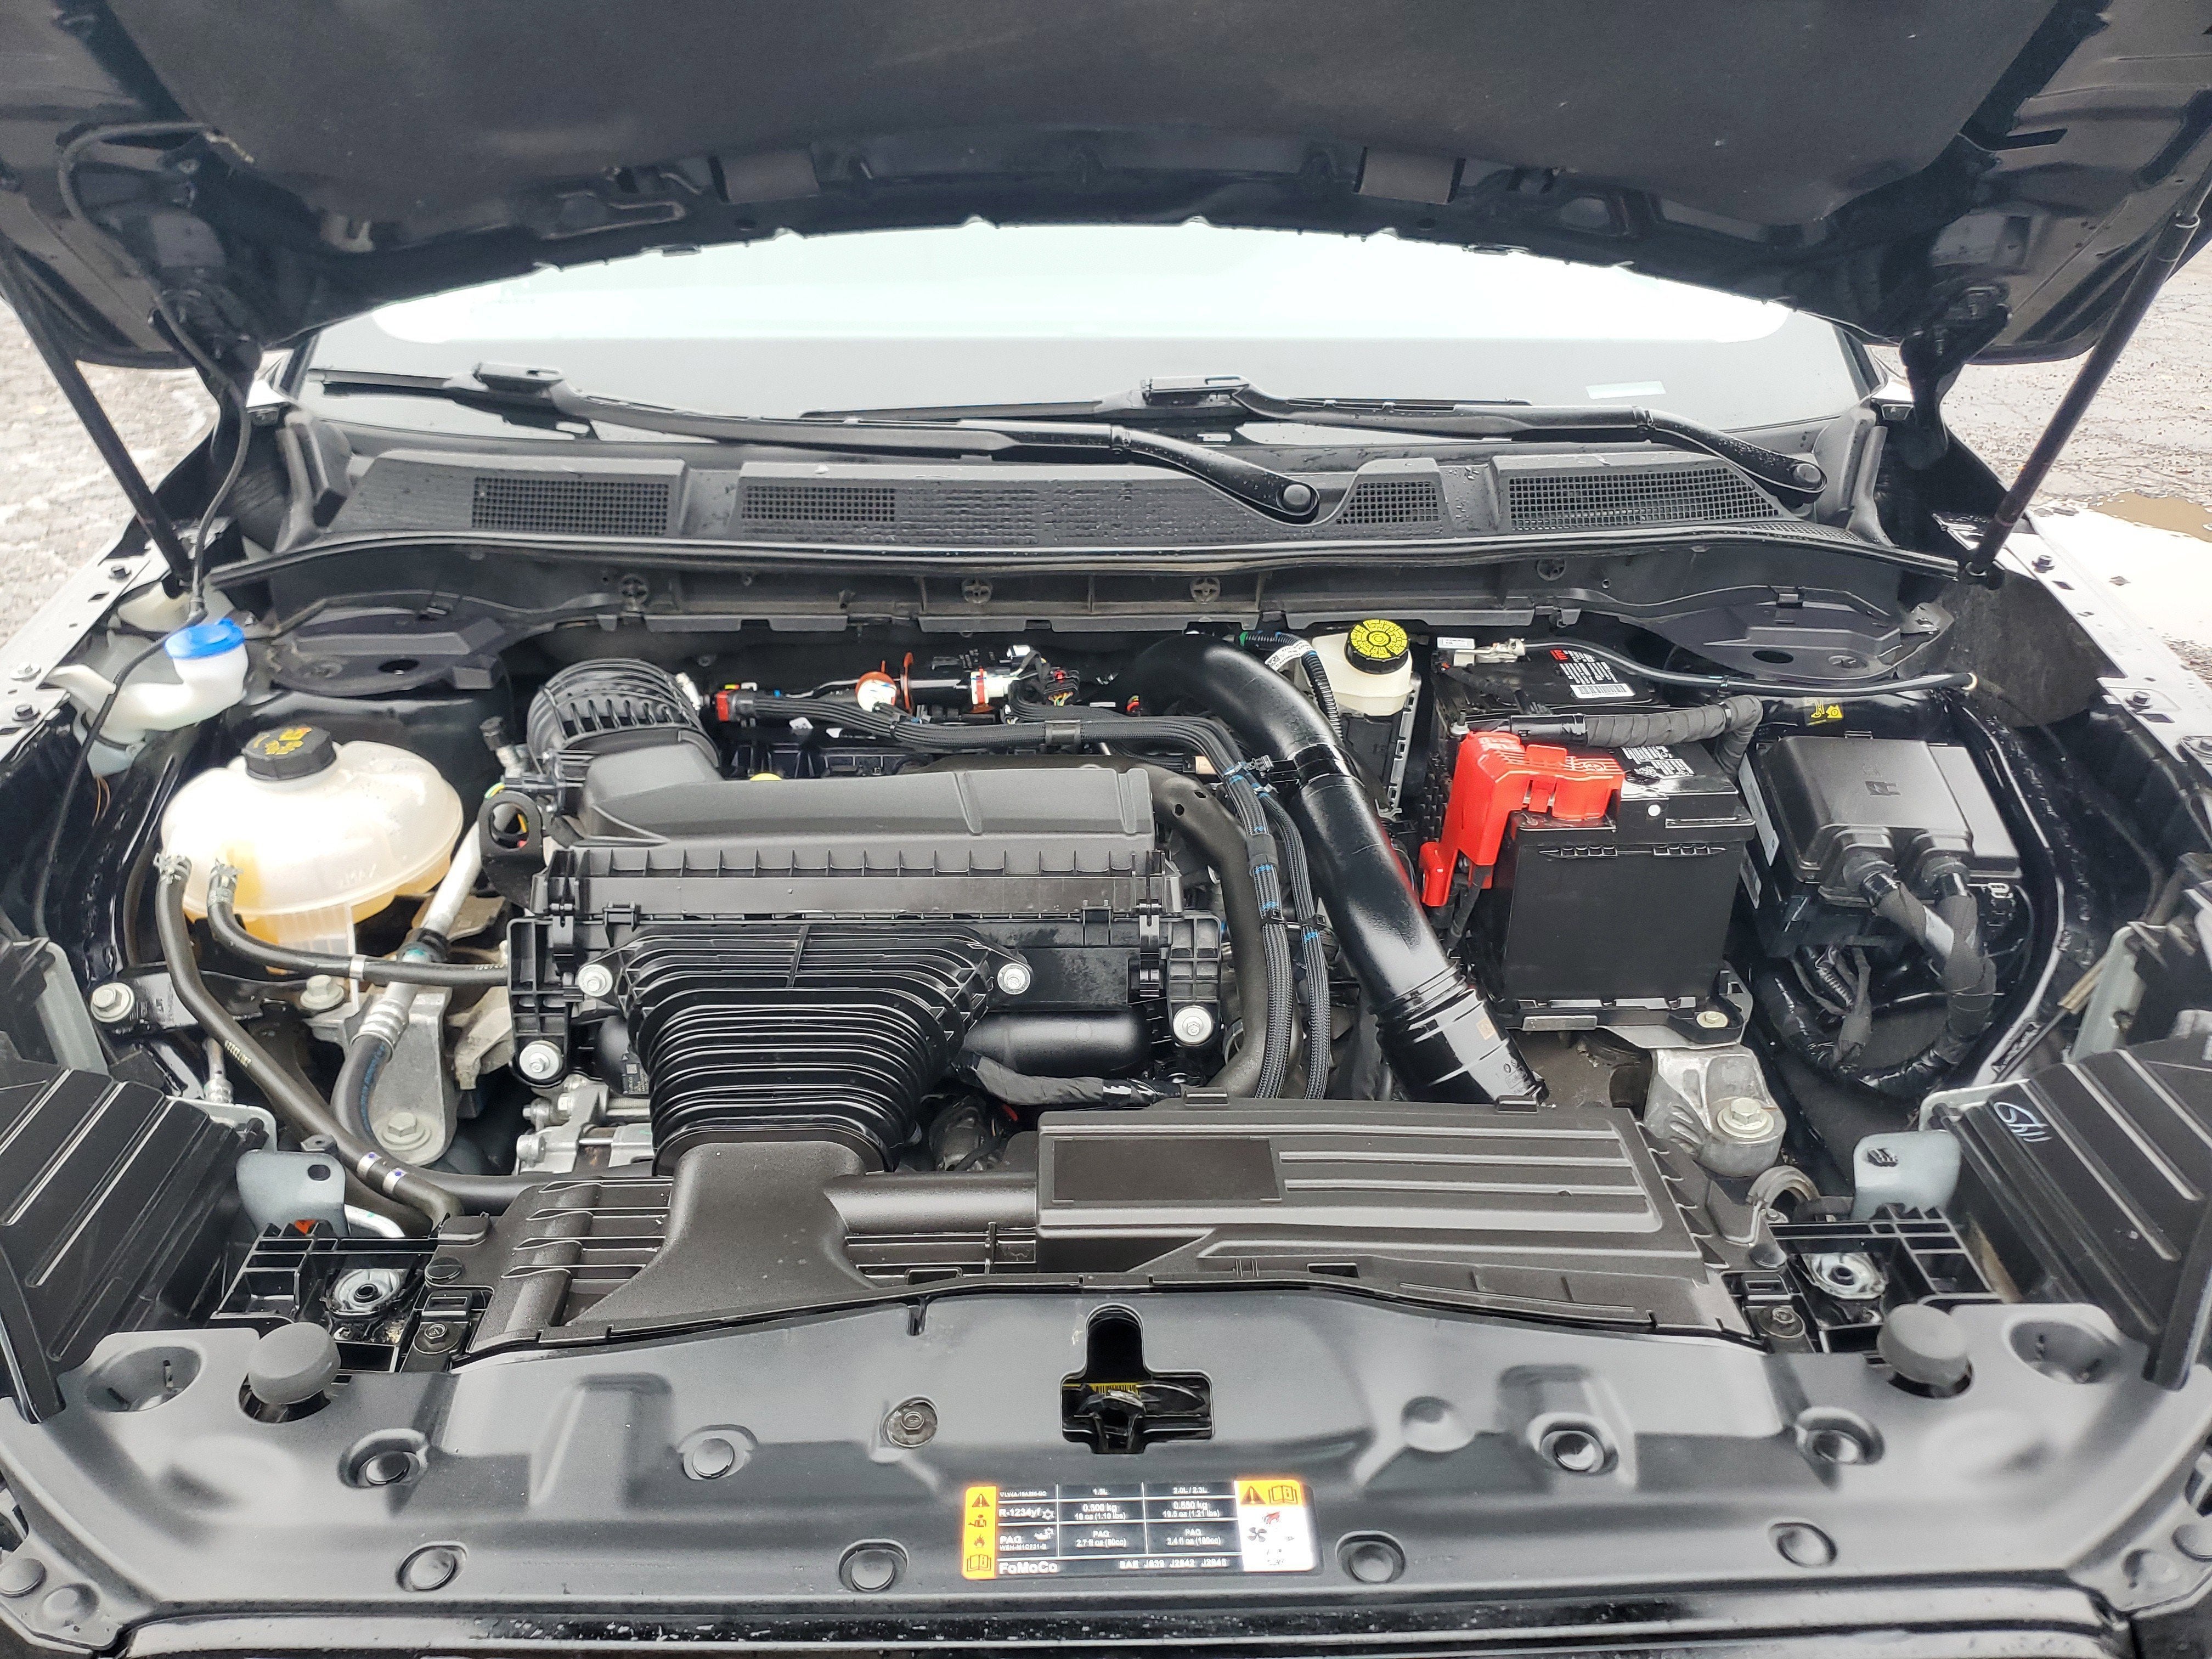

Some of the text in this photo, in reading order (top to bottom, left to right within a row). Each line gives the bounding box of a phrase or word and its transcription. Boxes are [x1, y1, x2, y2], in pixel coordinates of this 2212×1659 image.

[1107, 1503, 1117, 1513] kg
[1197, 1500, 1208, 1511] kg
[999, 1506, 1041, 1517] R-1234yf
[1000, 1536, 1022, 1544] PAG
[999, 1560, 1058, 1575] FoMoCo
